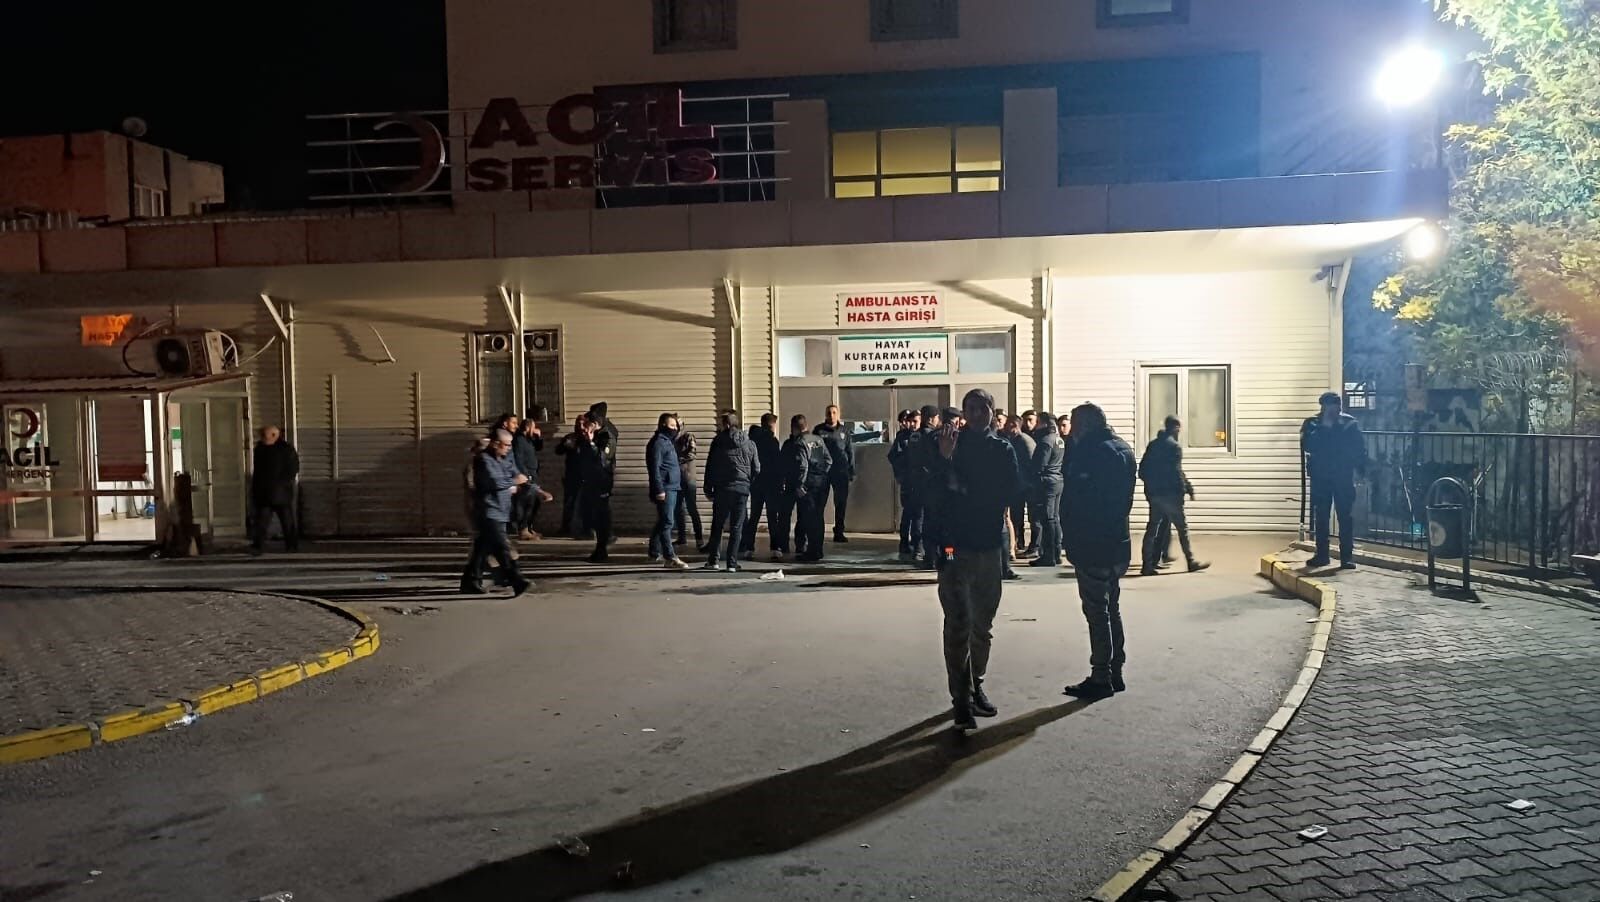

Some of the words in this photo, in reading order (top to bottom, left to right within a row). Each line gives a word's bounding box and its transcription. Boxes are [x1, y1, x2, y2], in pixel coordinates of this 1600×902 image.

[847, 312, 891, 323] HASTA
[895, 308, 936, 323] GİRİŞİ
[875, 340, 911, 349] HAYAT
[844, 352, 915, 361] KURTARMAK
[918, 350, 941, 361] İÇİN
[861, 363, 926, 372] BURADAYIZ
